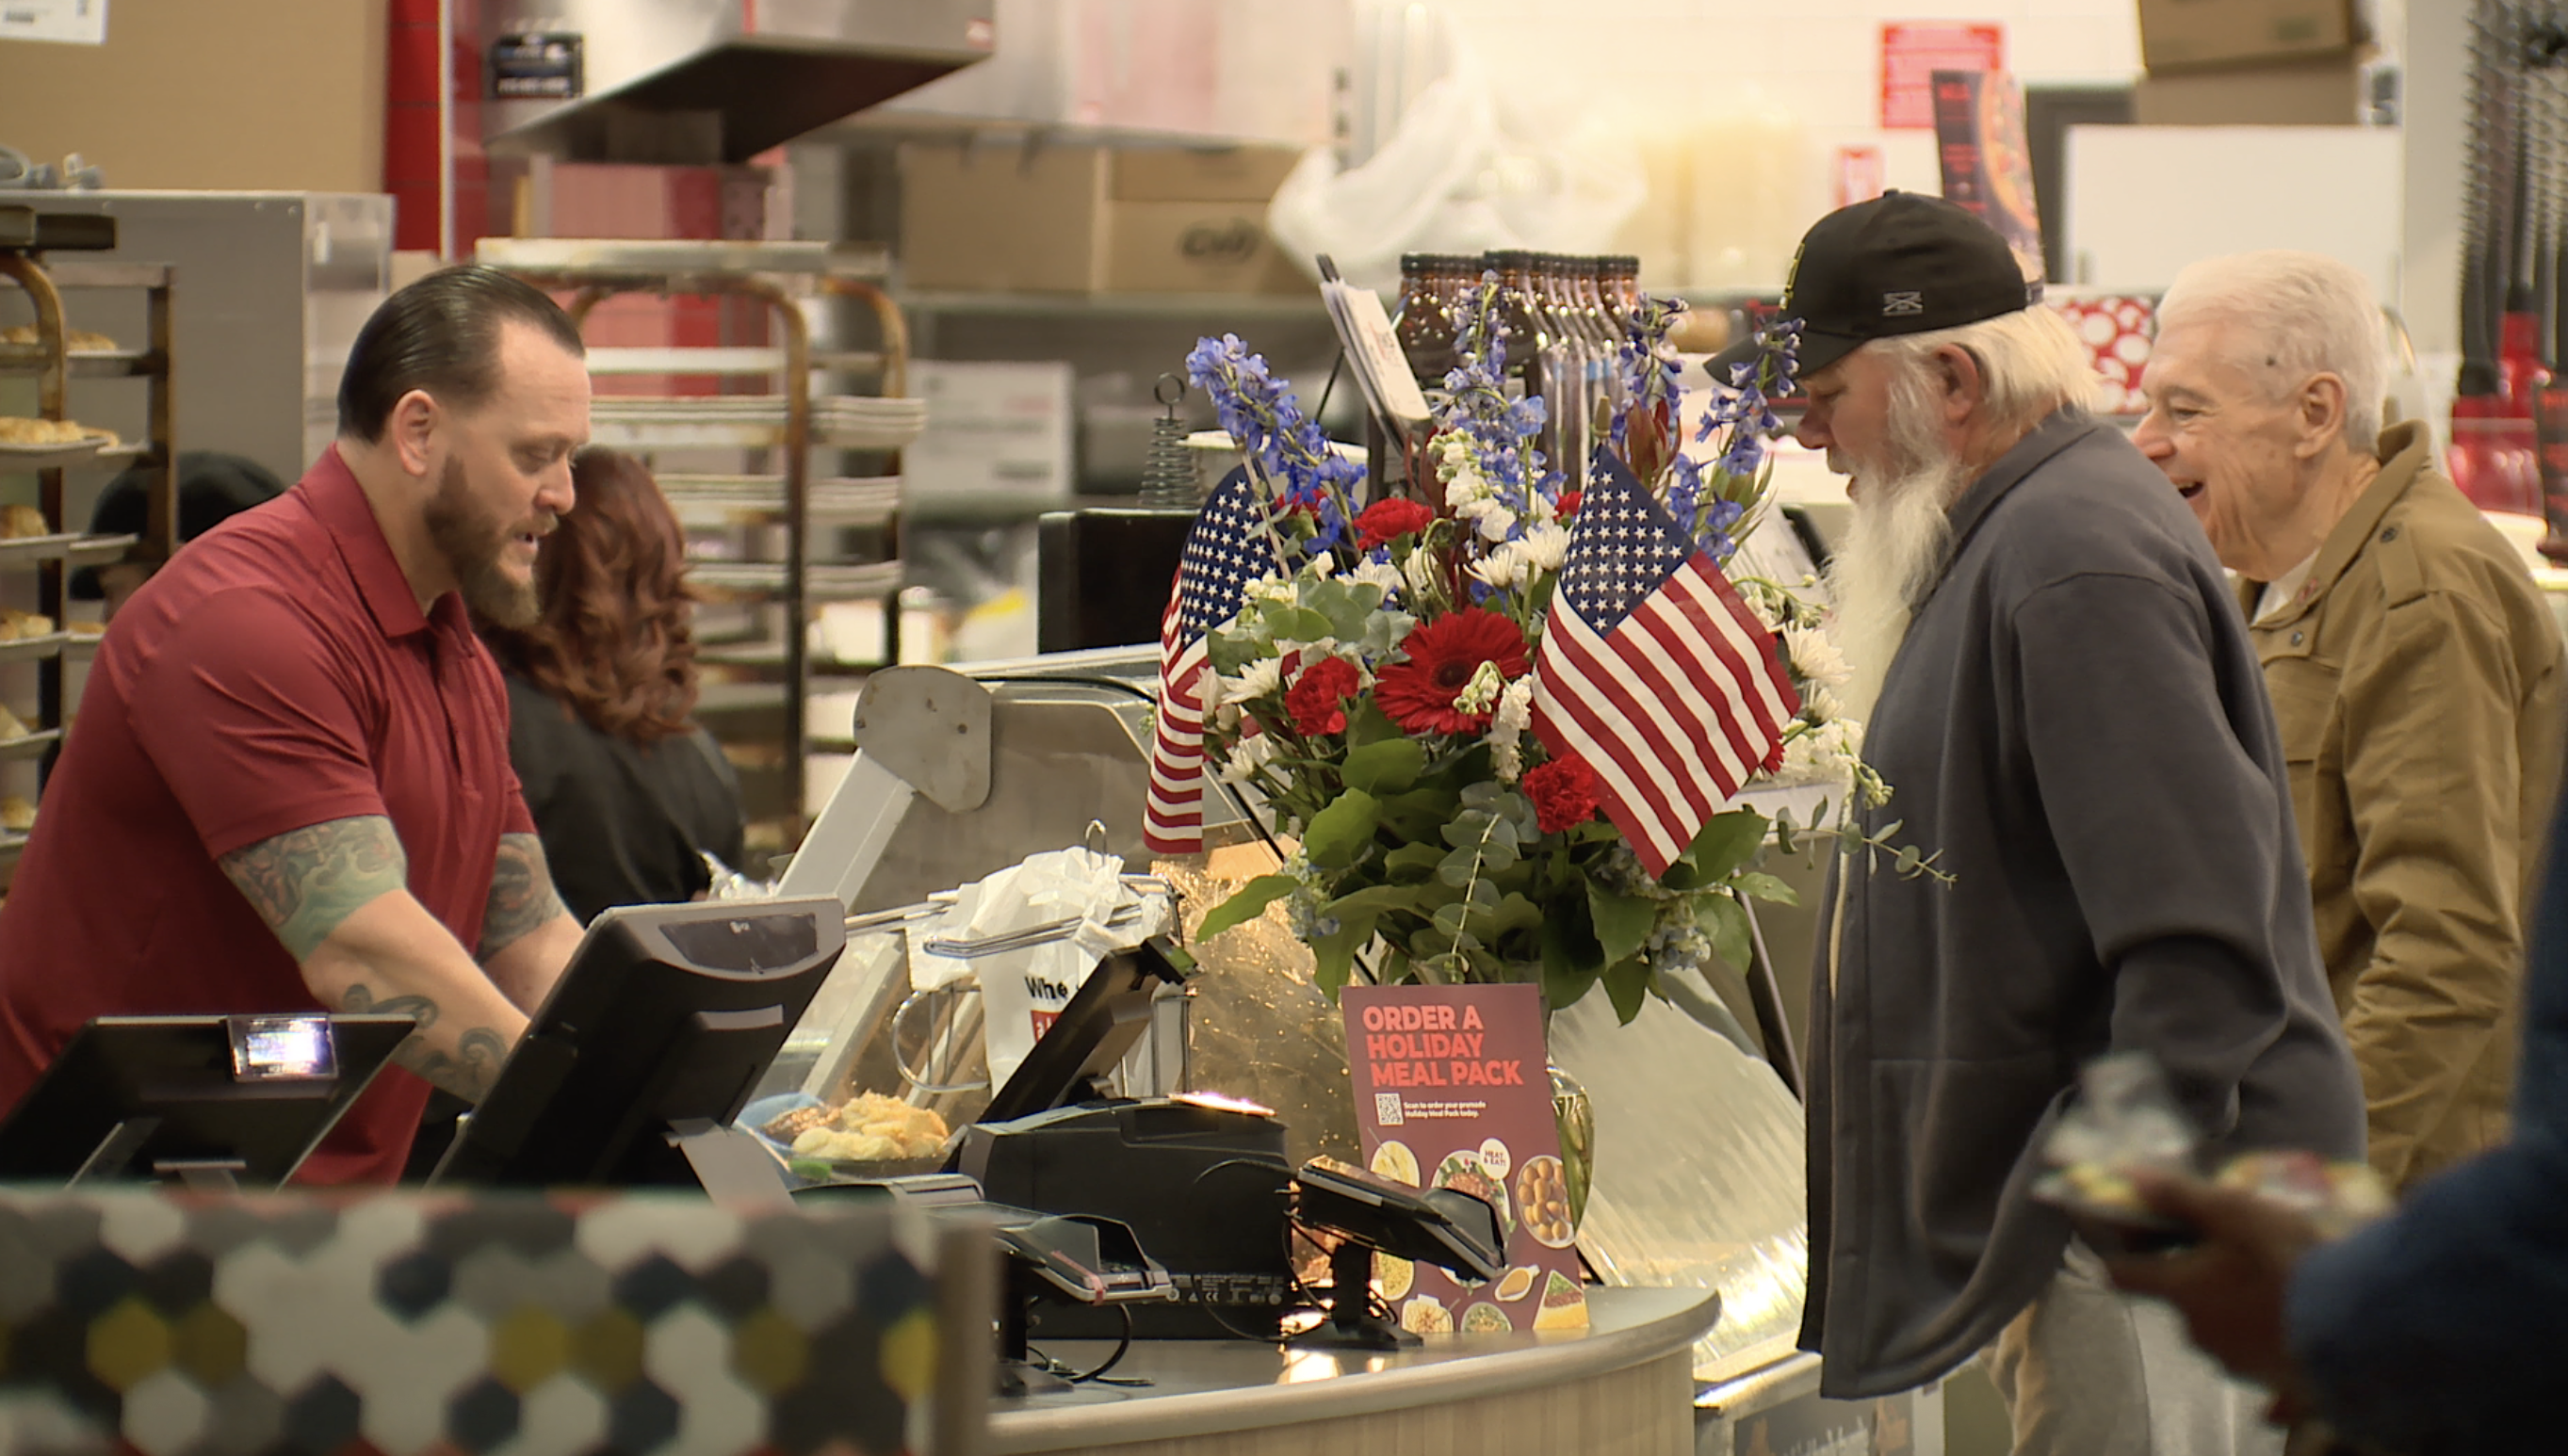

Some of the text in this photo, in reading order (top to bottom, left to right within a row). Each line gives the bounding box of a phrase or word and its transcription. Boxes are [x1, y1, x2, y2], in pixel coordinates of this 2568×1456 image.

[1362, 1004, 1484, 1031] ORDER A
[1366, 1032, 1485, 1060] HOLIDAY
[1370, 1060, 1523, 1087] MEAL PACK
[1405, 1110, 1428, 1119] Holiday
[1444, 1102, 1458, 1110] your
